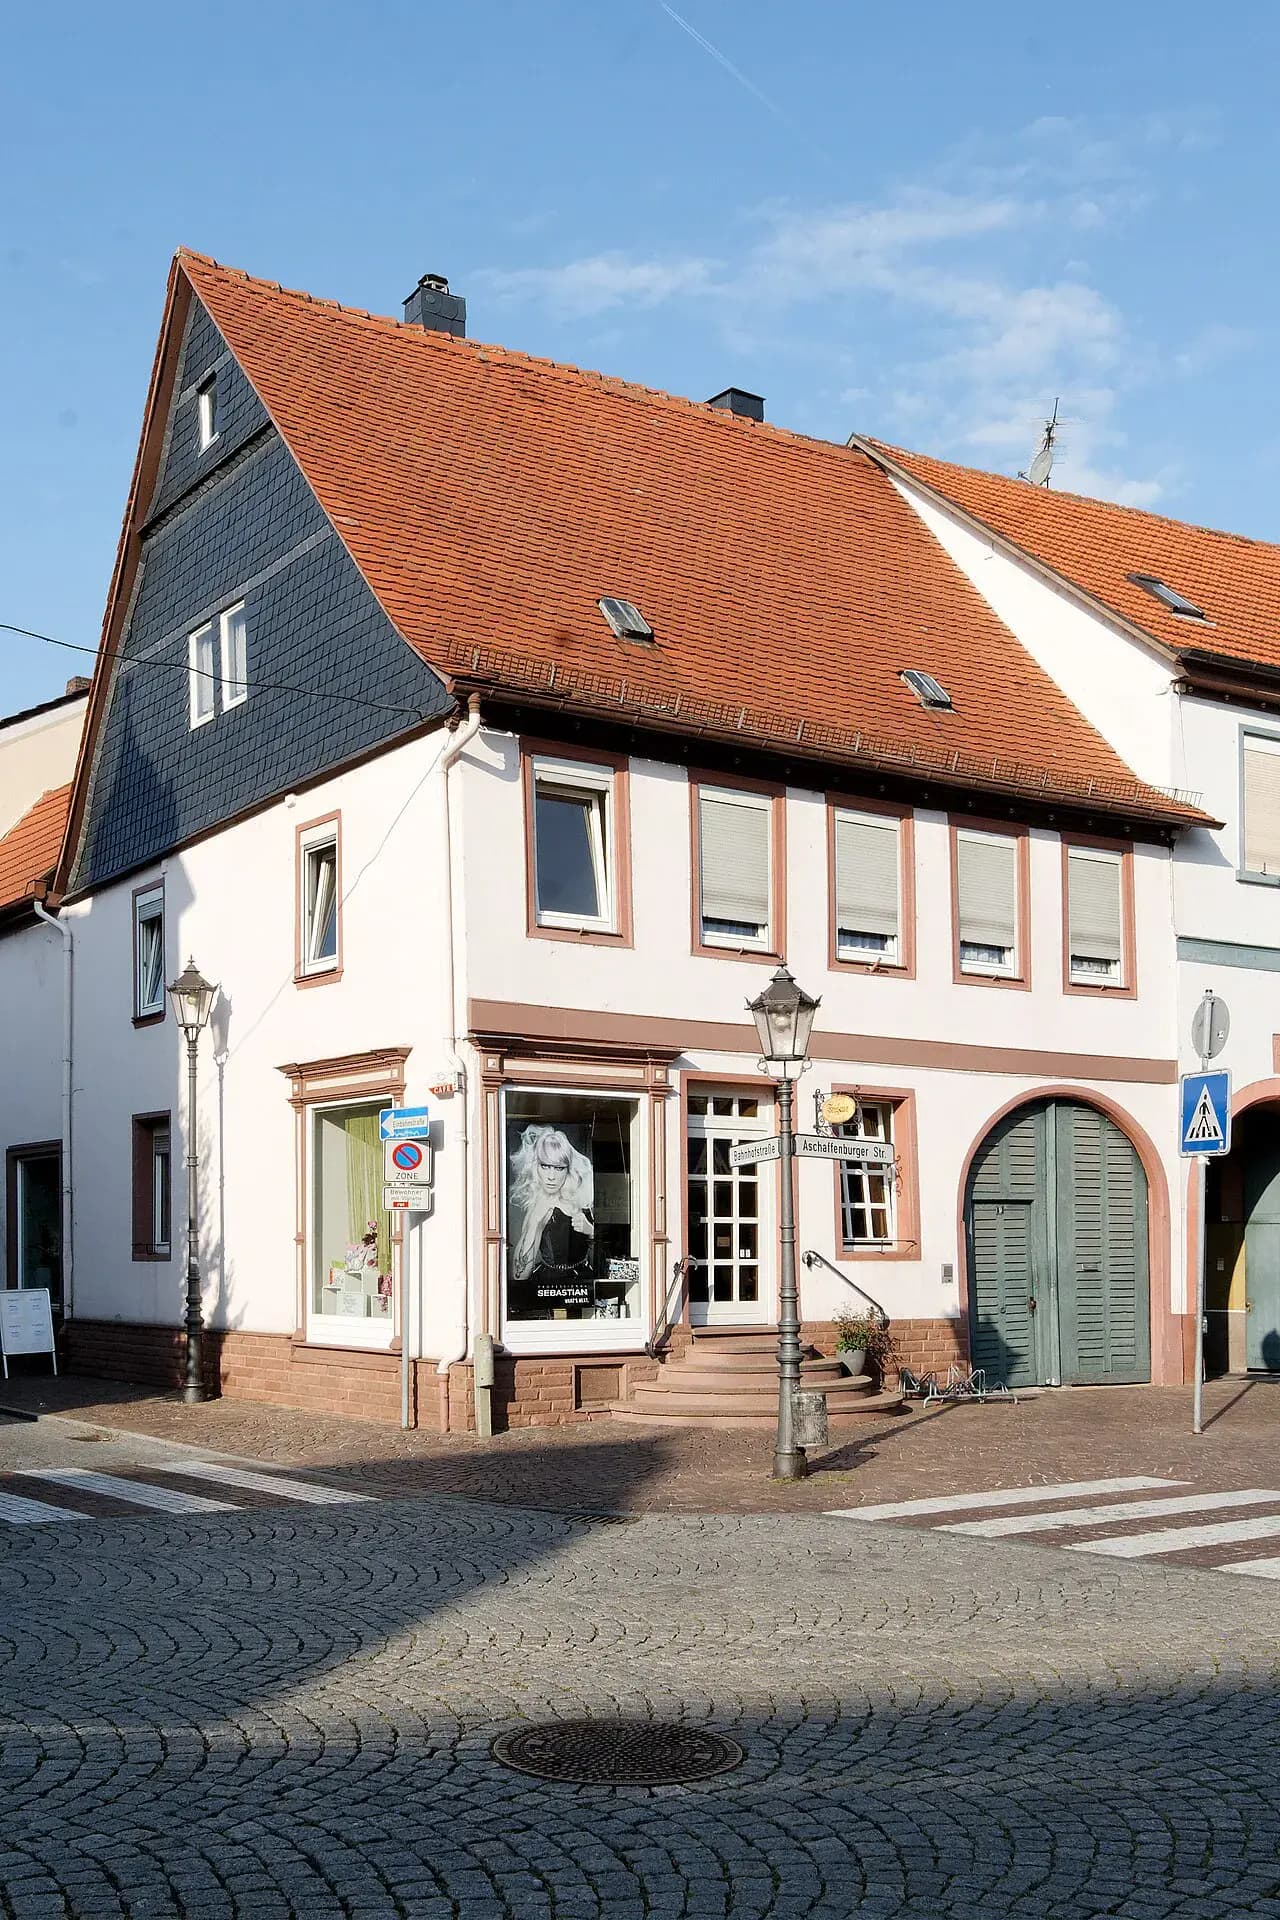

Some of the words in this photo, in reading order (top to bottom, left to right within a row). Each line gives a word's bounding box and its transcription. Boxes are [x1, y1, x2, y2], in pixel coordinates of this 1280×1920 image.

[733, 1143, 776, 1162] Bahnhofstraße
[802, 1140, 869, 1159] Aschaffenburger
[873, 1147, 887, 1159] Str.
[395, 1172, 419, 1180] ZONE
[537, 1288, 588, 1297] SEBASTIAN
